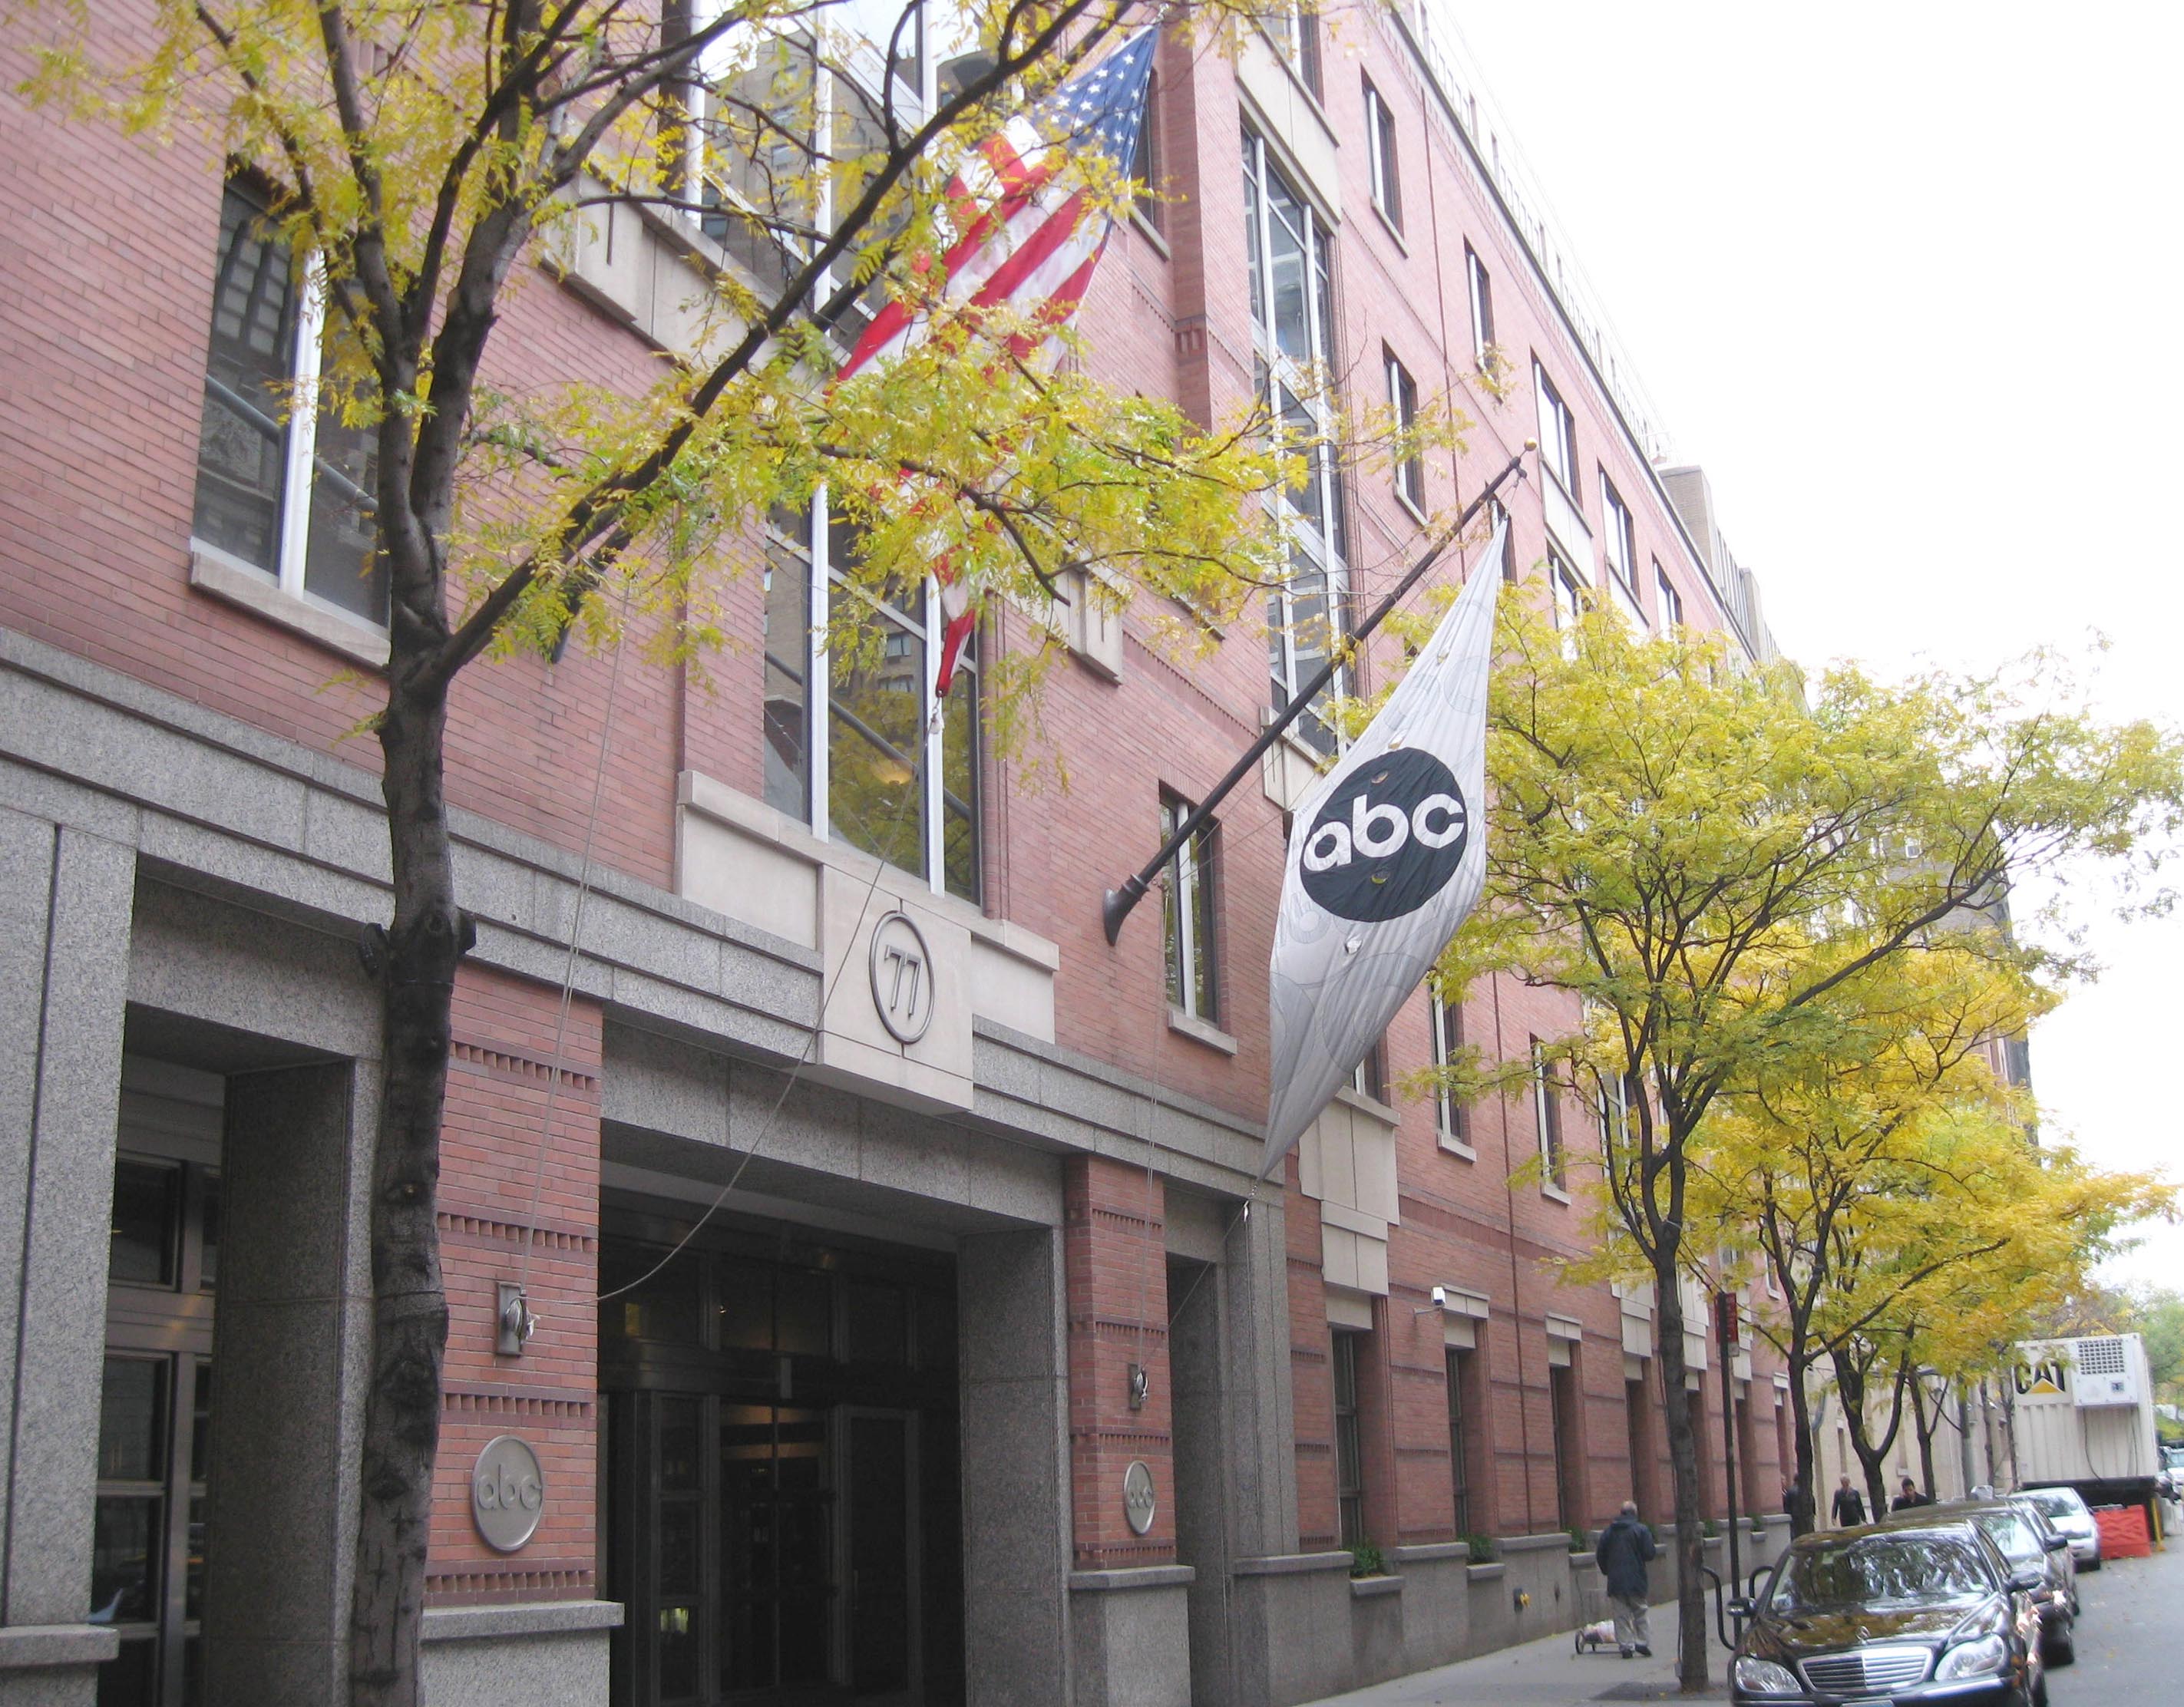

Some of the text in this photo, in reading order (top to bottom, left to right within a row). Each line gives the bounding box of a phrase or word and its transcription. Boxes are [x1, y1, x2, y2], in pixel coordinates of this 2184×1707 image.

[1303, 793, 1466, 872] abc
[884, 944, 923, 1019] 77
[477, 1464, 543, 1511] abc
